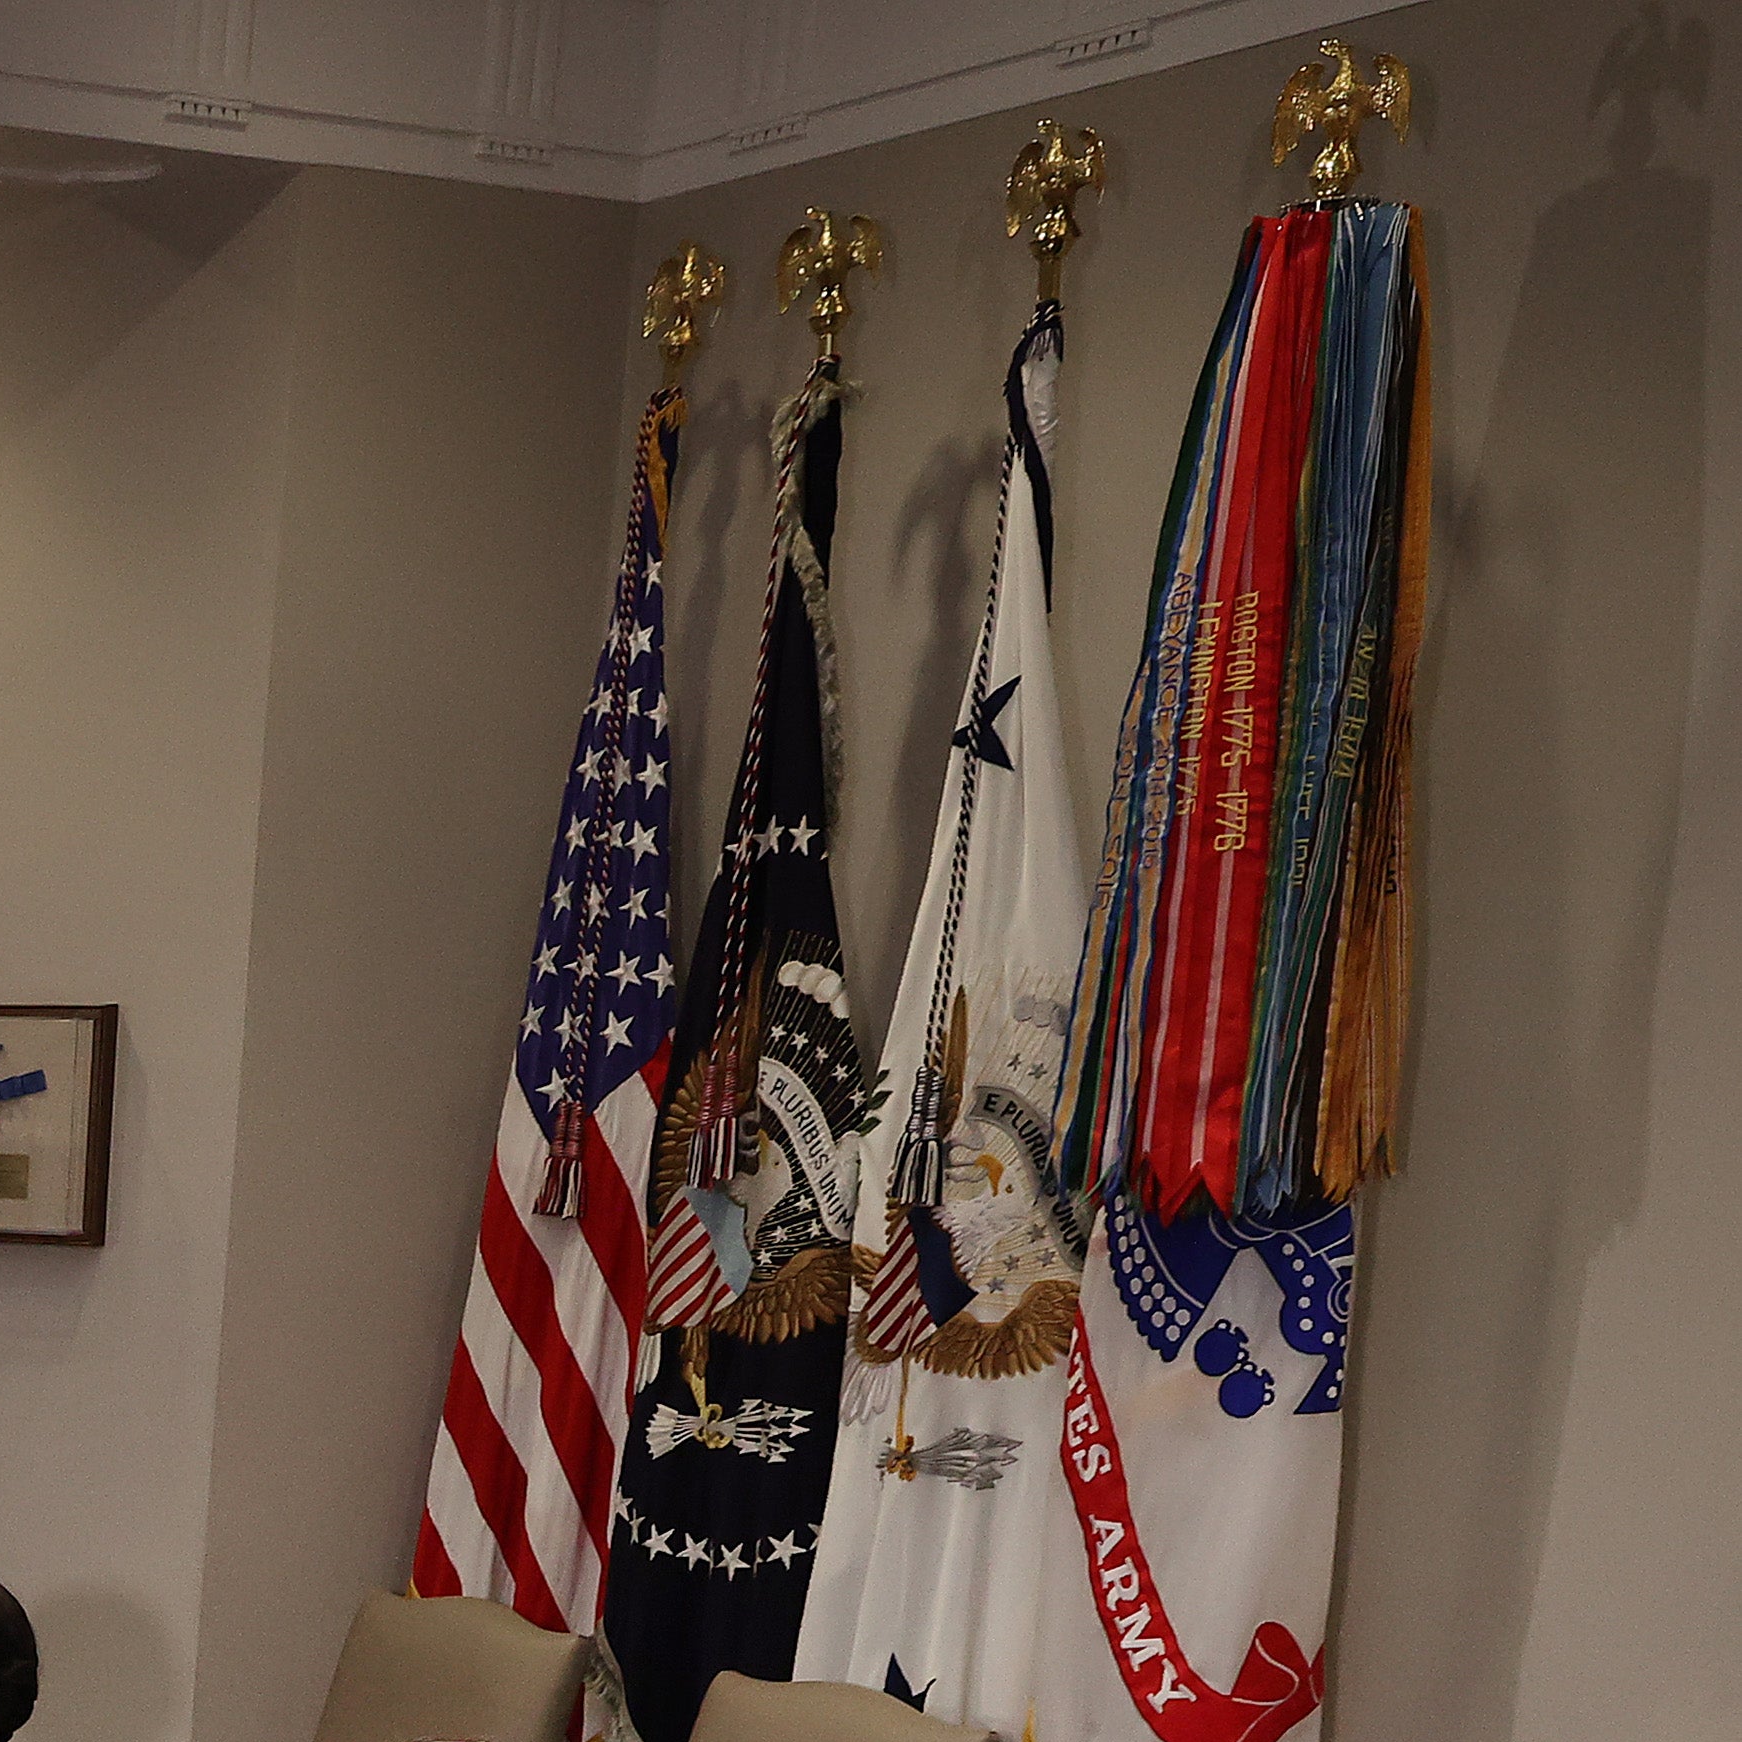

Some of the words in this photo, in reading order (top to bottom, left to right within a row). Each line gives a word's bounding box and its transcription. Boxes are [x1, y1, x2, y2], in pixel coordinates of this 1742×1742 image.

[1151, 572, 1198, 726] ABEYANCE
[1223, 591, 1260, 694] BOSTON
[769, 1077, 830, 1171] PLURIBUS
[818, 1170, 854, 1230] UNUM
[983, 1093, 1001, 1113] E
[1066, 1327, 1113, 1484] TES
[1087, 1514, 1198, 1716] ARMY
